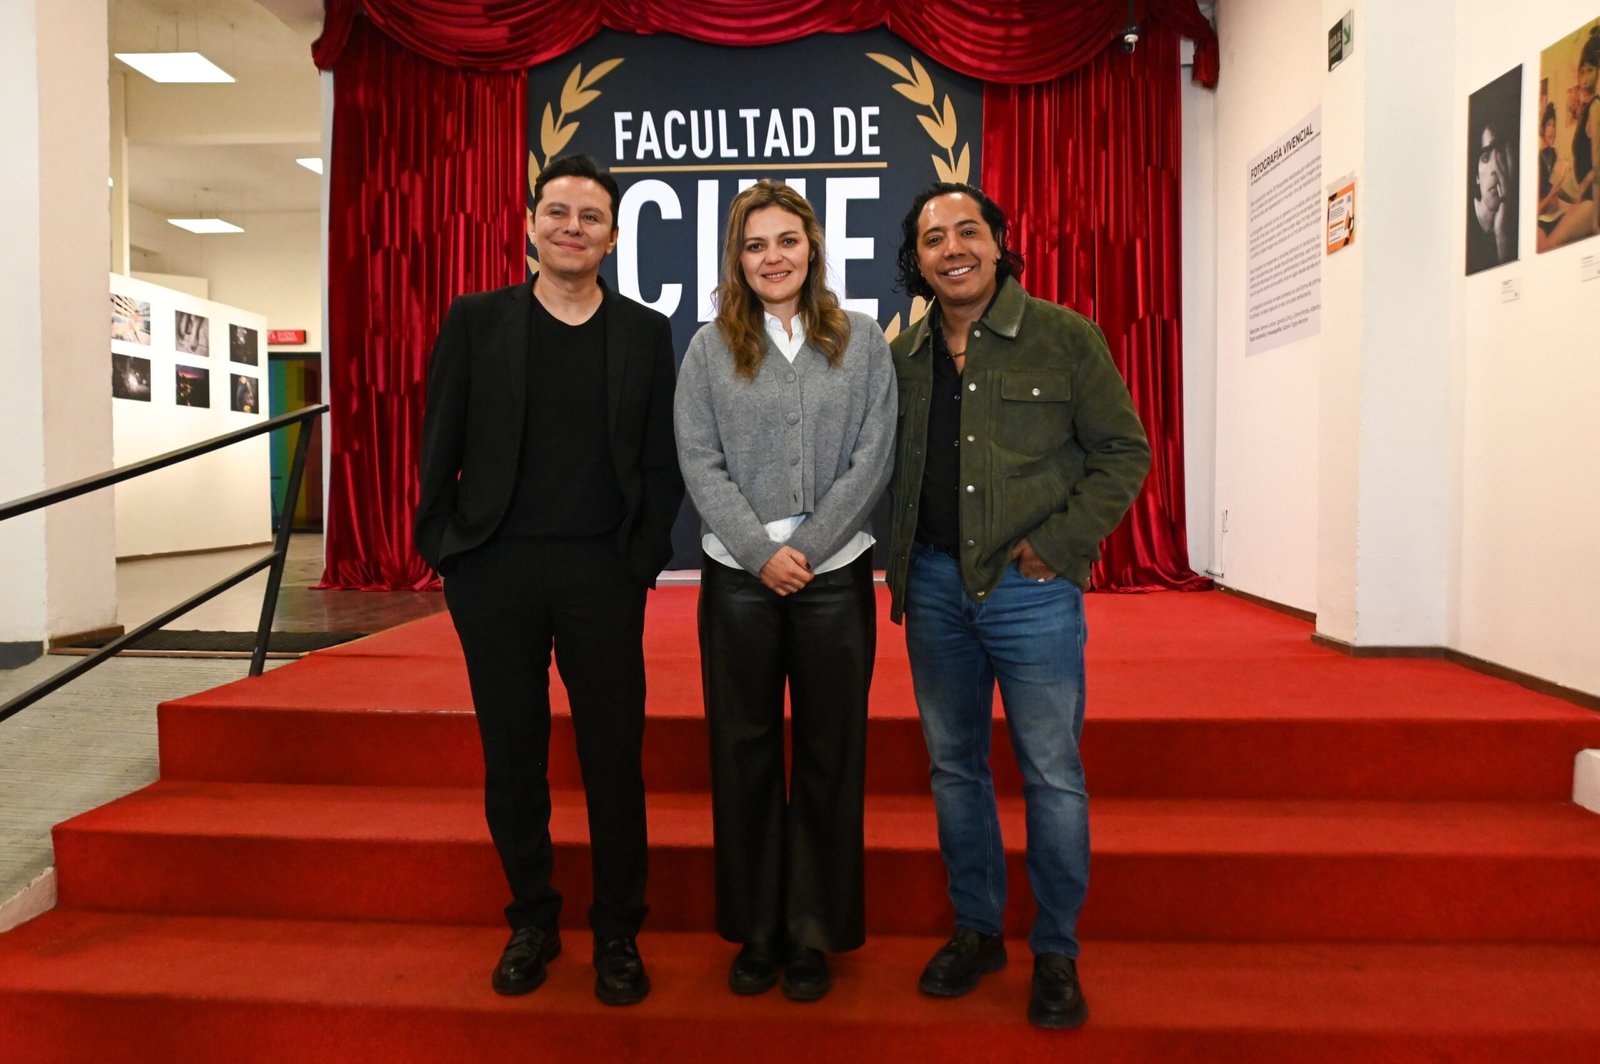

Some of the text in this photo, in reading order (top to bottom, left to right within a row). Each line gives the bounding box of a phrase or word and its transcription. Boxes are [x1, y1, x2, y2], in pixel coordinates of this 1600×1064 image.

[613, 106, 881, 160] FACULTAD DE
[1250, 146, 1283, 180] FOTOGRAFÍA
[1283, 123, 1314, 154] VIVENCIAL
[617, 176, 880, 322] CIE
